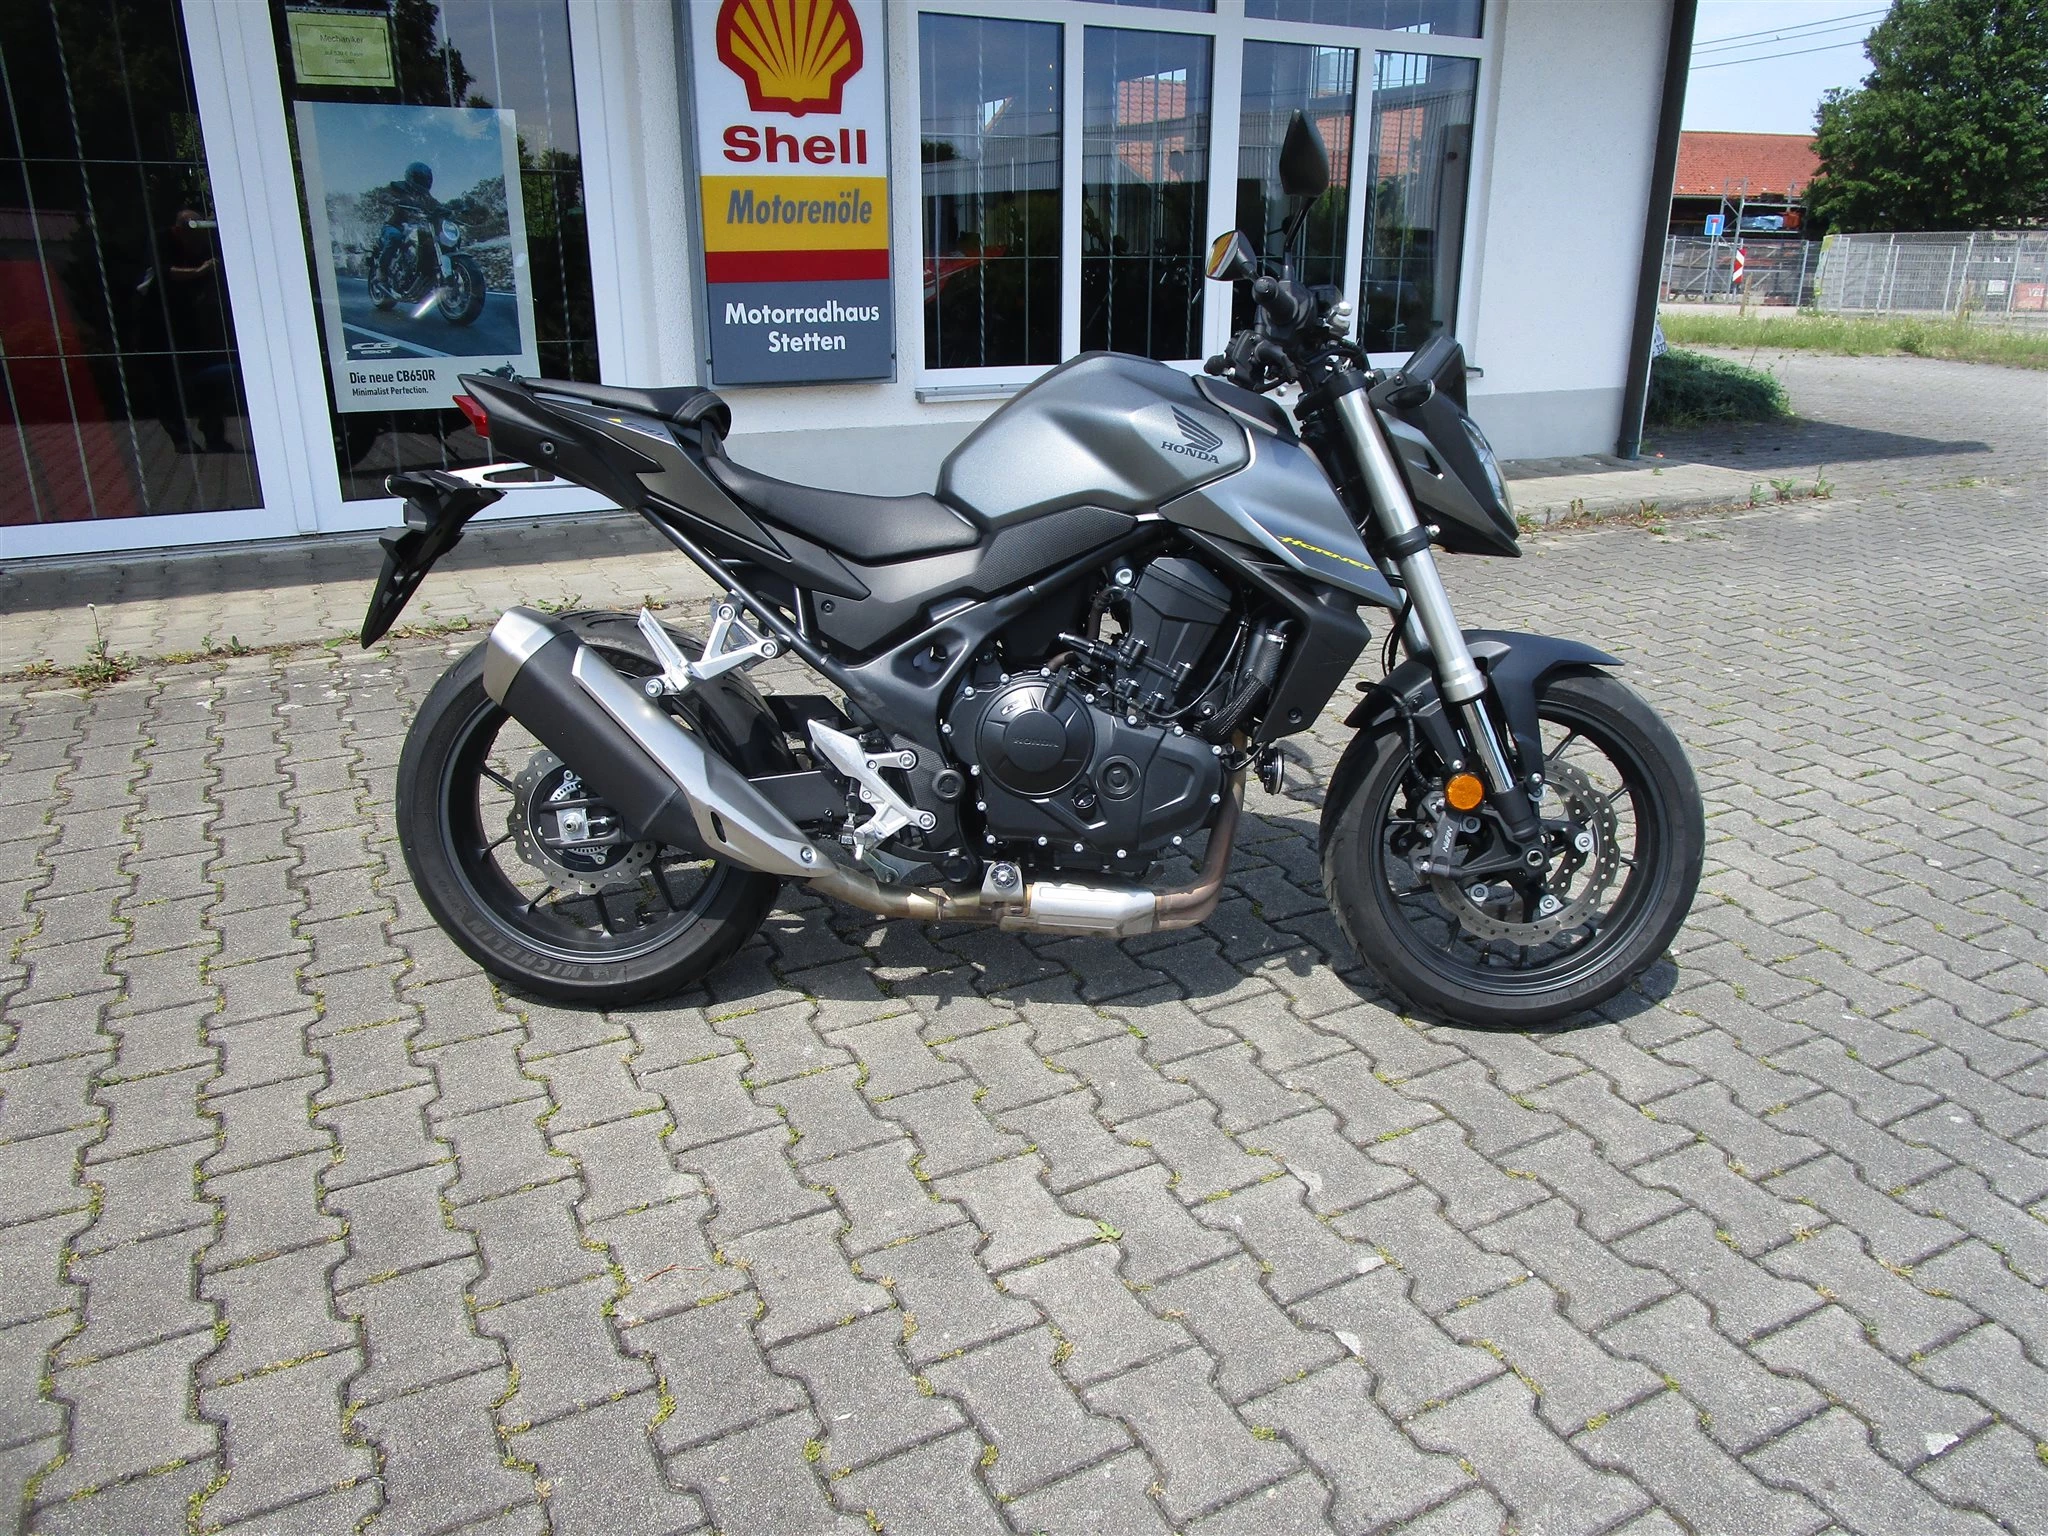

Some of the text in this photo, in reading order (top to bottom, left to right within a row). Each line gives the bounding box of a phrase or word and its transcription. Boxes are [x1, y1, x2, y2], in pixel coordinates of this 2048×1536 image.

[722, 125, 867, 165] Shell
[726, 188, 872, 225] Motorenöle
[725, 300, 880, 325] Motorradhaus
[768, 331, 846, 353] Stetten
[349, 369, 436, 384] Die neue CB650R
[352, 385, 429, 396] Minimalist Perfection.
[1161, 441, 1220, 464] HONDA
[467, 917, 586, 978] MICHELIN
